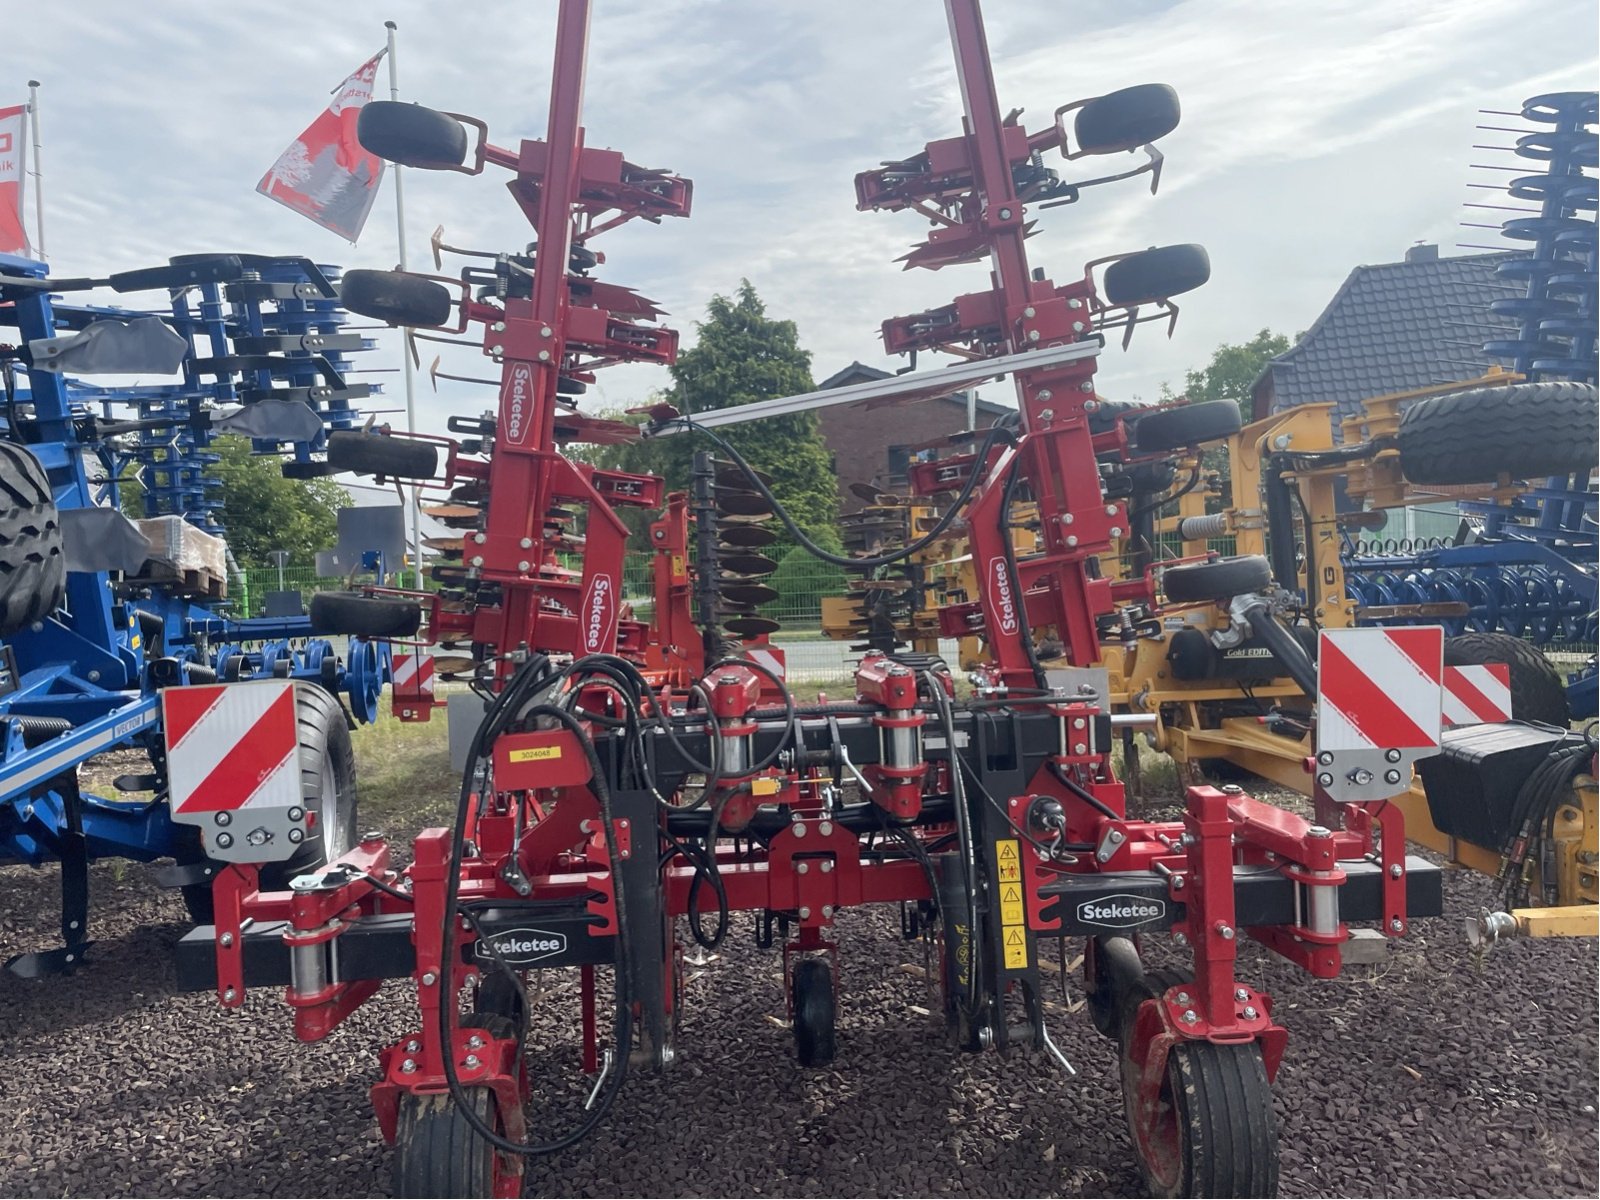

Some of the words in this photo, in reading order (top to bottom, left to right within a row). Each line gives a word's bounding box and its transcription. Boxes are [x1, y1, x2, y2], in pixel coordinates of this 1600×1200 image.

[509, 368, 529, 438] Steketee
[588, 580, 608, 648] Steketee
[995, 562, 1016, 630] Steketee
[1083, 903, 1159, 920] Steketee
